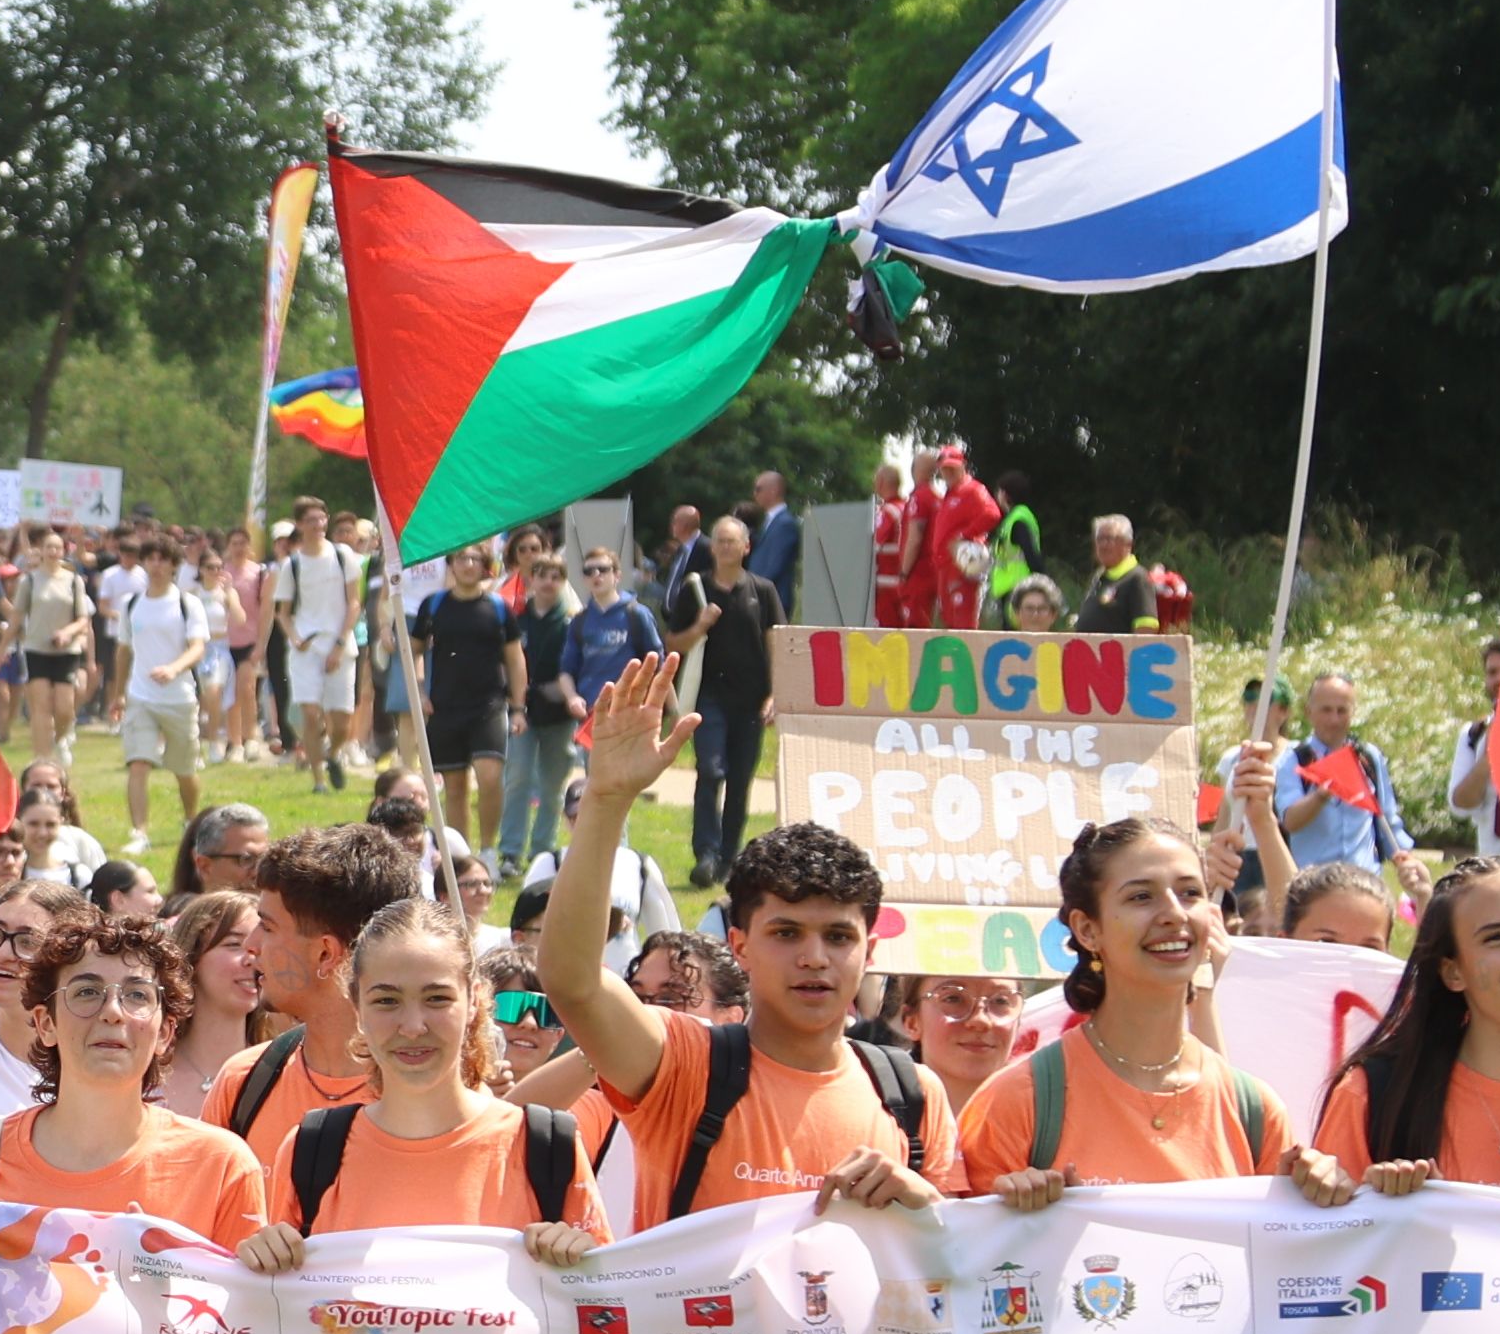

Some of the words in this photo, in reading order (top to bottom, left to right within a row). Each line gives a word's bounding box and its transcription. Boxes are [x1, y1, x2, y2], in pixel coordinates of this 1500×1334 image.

[809, 630, 1178, 720] IMAGINE
[874, 719, 987, 761] ALL
[1001, 724, 1100, 767] THE
[808, 762, 1159, 848] PEOPLE
[734, 1162, 791, 1185] Quarto
[1263, 1222, 1288, 1232] CON
[1289, 1222, 1301, 1232] IL
[1301, 1219, 1360, 1232] SOSTEGNO
[1361, 1218, 1375, 1228] DI
[133, 1255, 184, 1271] INIZIATIVA
[300, 1274, 366, 1285] ALL'INTERNO
[368, 1275, 394, 1285] DEL
[396, 1275, 438, 1286] FESTIVAL
[560, 1274, 585, 1285] CON
[586, 1274, 597, 1284] IL
[597, 1267, 662, 1283] PATROCINIO
[662, 1266, 677, 1277] DI
[1277, 1276, 1343, 1289] COESIONE
[1278, 1287, 1318, 1299] ITALIA
[328, 1302, 455, 1333] YouTopic
[462, 1306, 517, 1328] Fest
